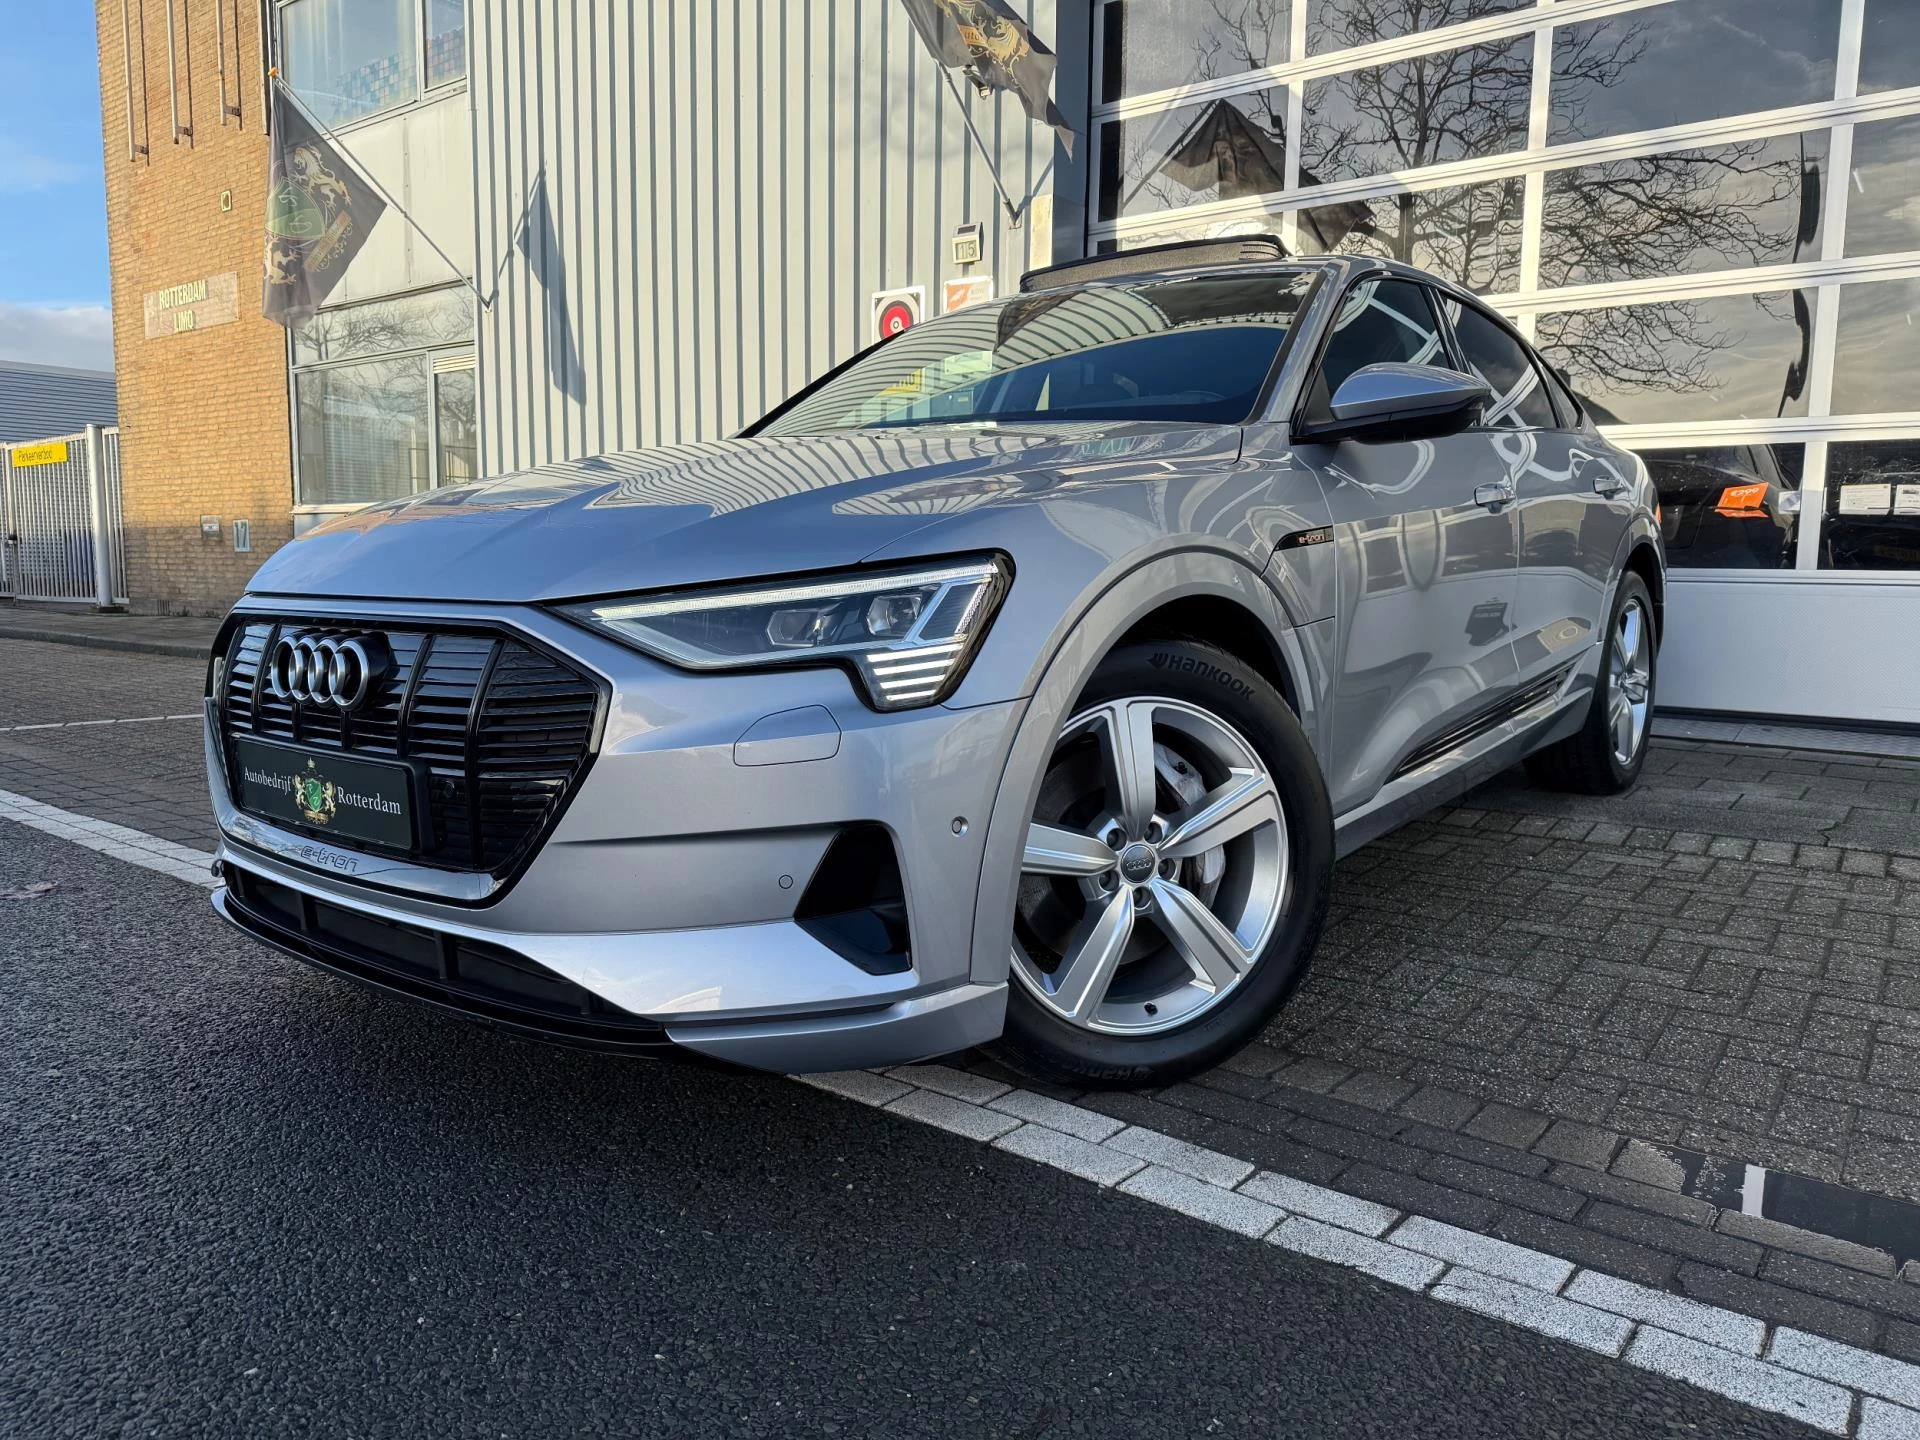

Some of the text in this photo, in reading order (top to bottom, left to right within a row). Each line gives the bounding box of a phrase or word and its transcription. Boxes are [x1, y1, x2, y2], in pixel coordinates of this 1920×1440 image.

[160, 279, 207, 310] ROTTERDAM
[173, 309, 194, 333] LIMO
[234, 521, 248, 549] 17
[1299, 533, 1325, 544] e-tron
[244, 766, 402, 815] Autobedrijf Rotterdam
[300, 845, 360, 873] e-tron
